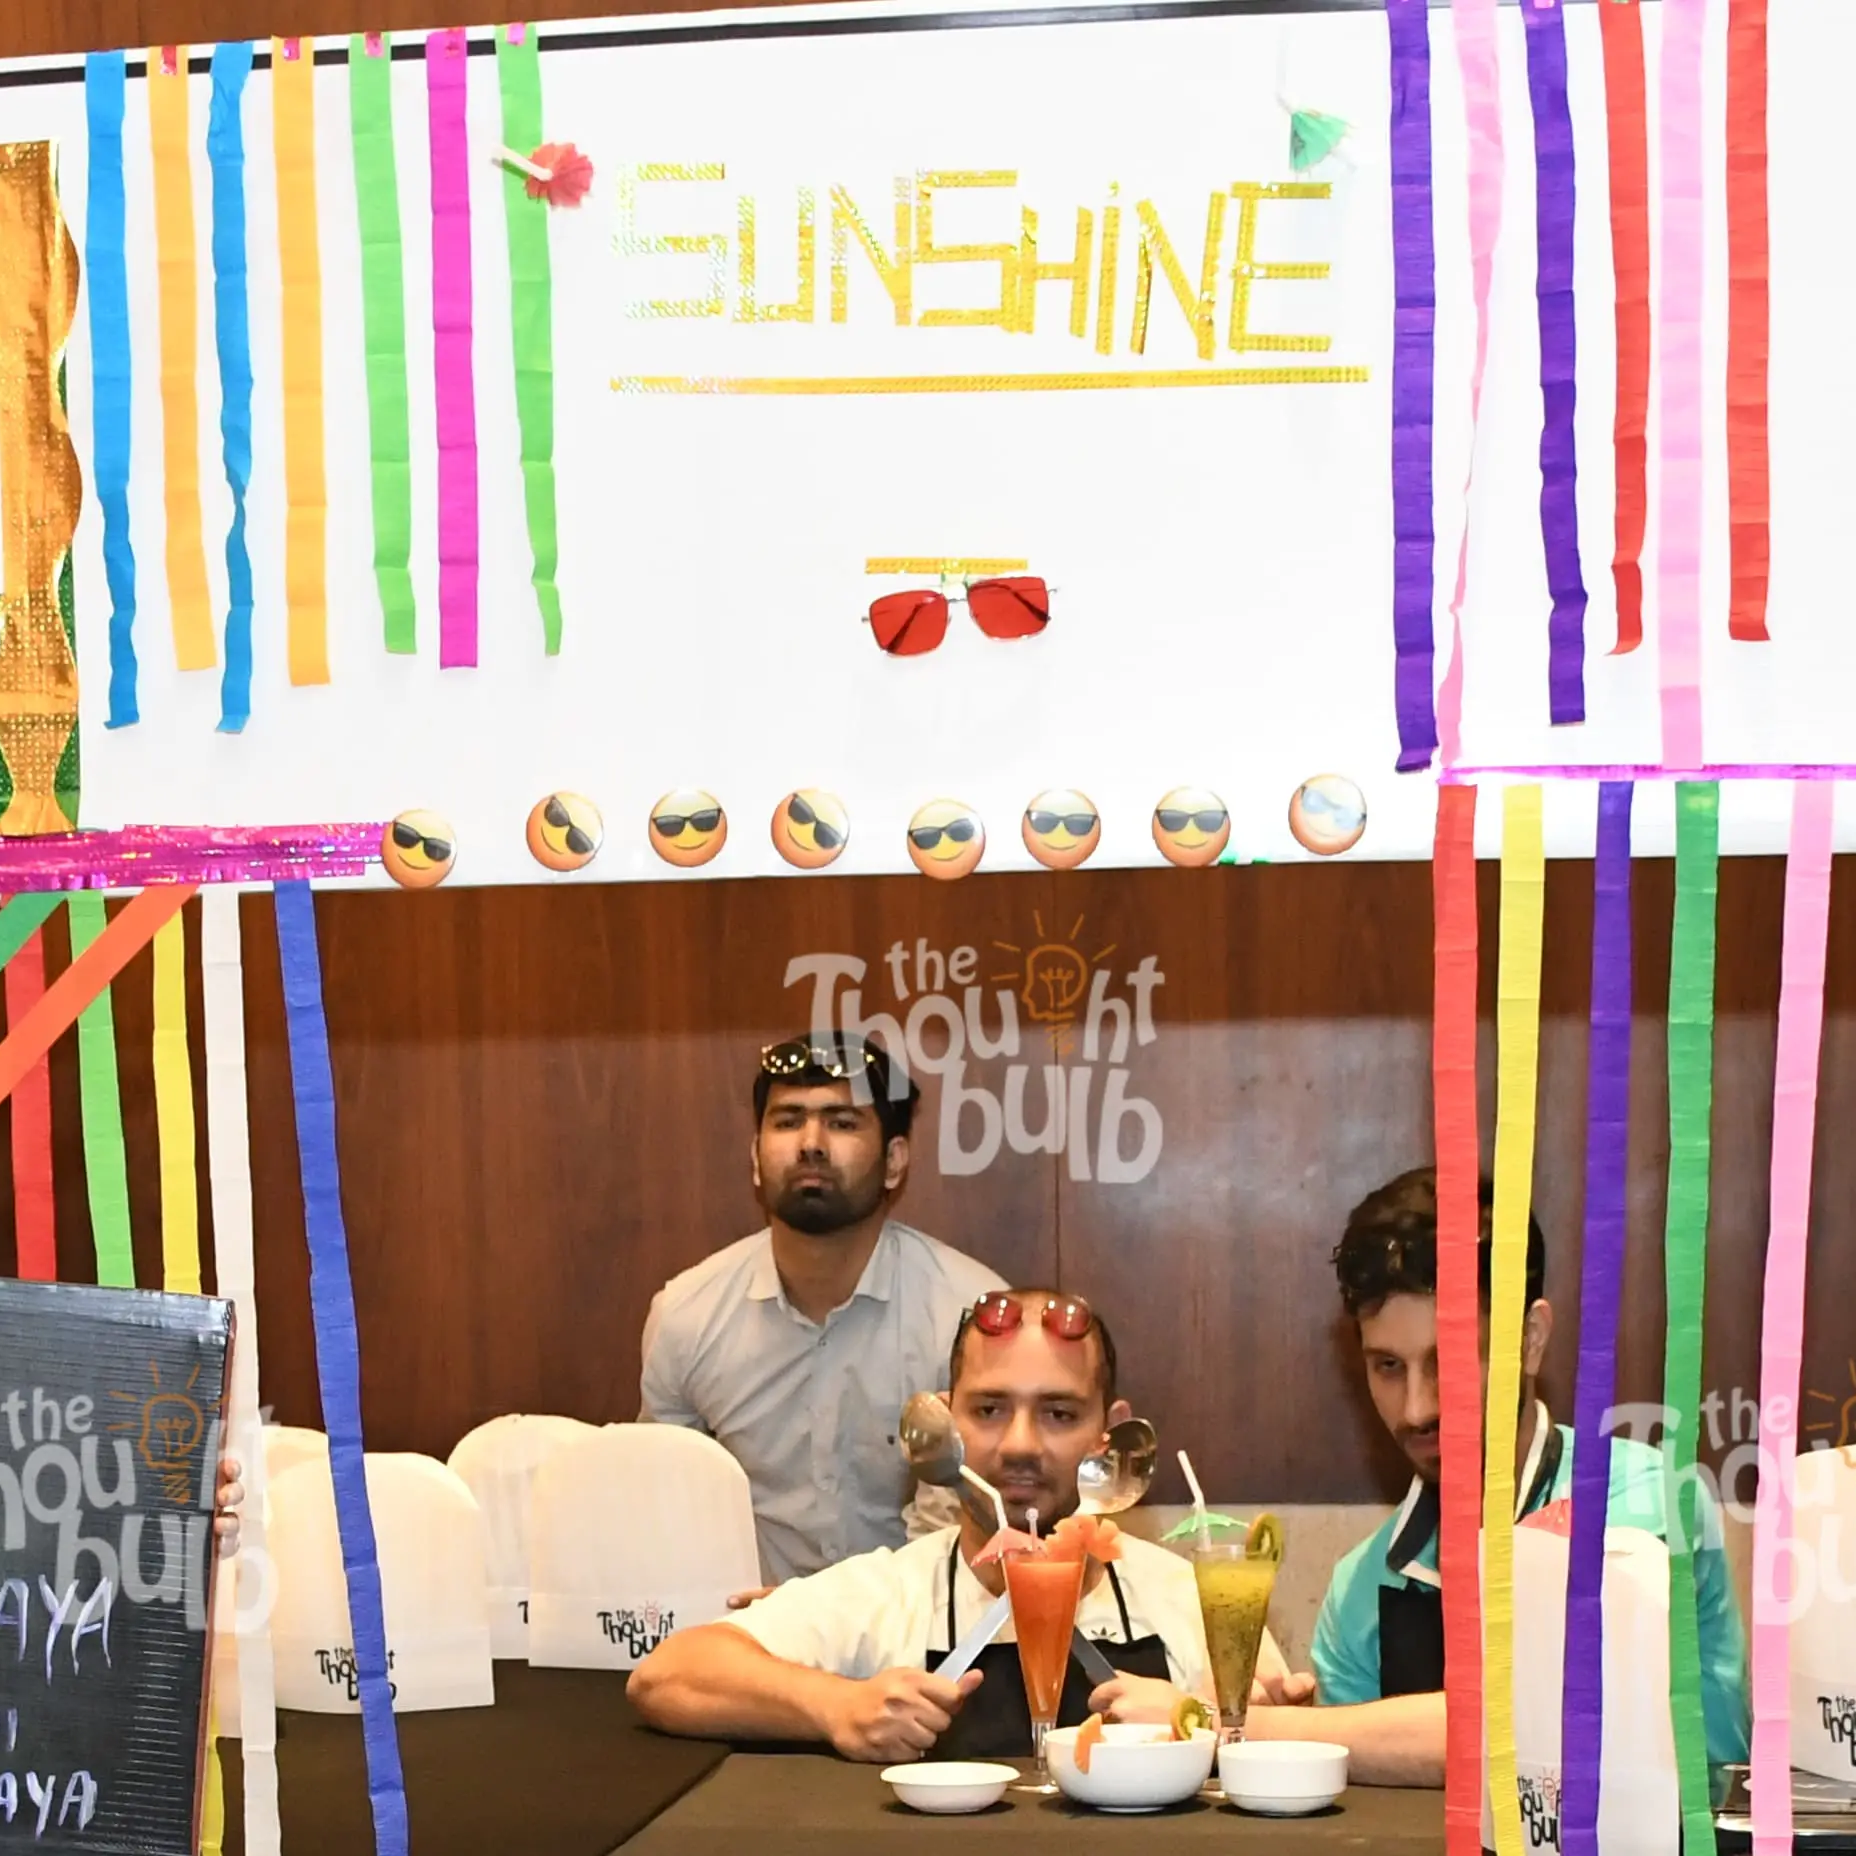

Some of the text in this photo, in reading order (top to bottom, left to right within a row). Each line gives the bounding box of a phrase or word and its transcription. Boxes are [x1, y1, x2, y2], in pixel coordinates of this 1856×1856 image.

[611, 161, 1334, 359] SUNSHINE
[629, 1634, 668, 1659] bu
[1531, 1813, 1560, 1853] bul
